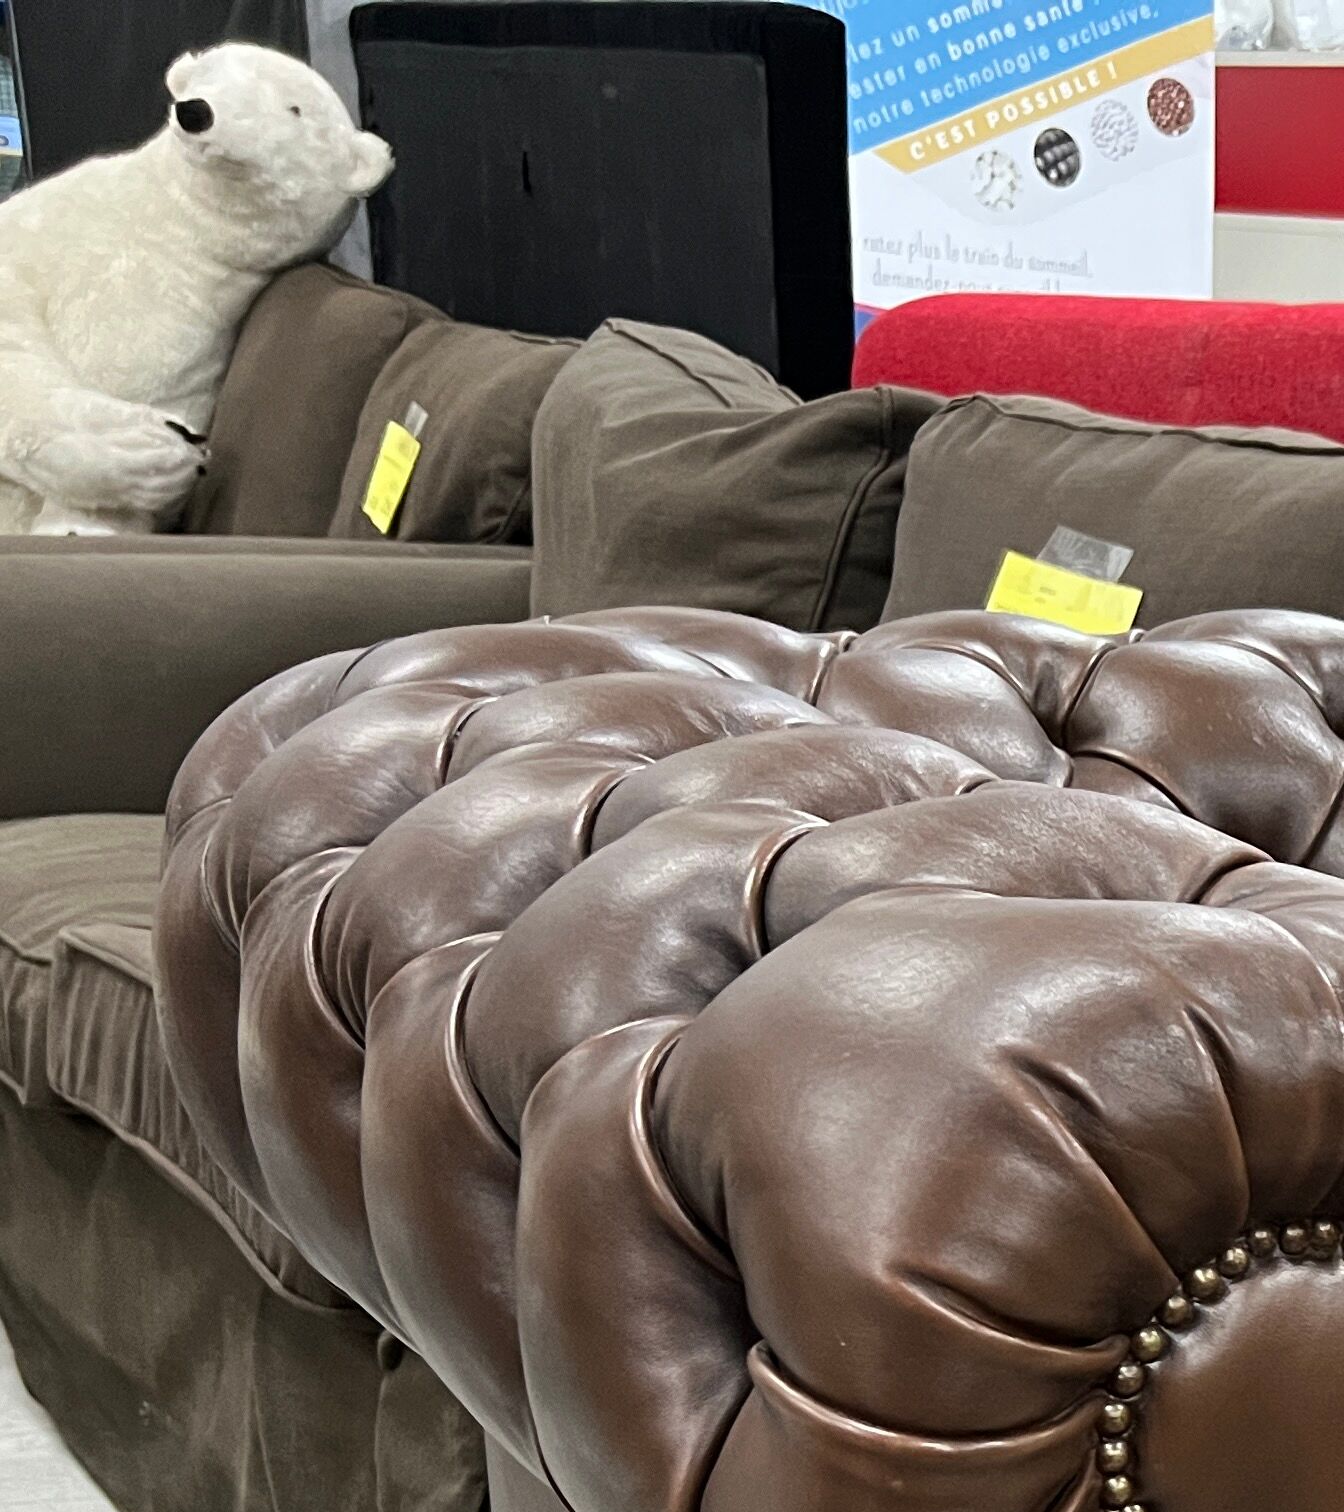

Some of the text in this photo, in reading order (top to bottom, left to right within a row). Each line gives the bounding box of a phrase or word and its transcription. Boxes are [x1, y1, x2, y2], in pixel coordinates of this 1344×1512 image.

[891, 24, 920, 47] un
[914, 52, 942, 76] en
[946, 21, 1017, 61] bonne
[853, 97, 914, 134] notre
[920, 44, 1050, 106] technologie
[909, 118, 977, 161] C'EST
[986, 69, 1101, 129] POSSIBLE
[946, 233, 960, 263] le
[964, 247, 1000, 267] train
[1004, 241, 1024, 271] du
